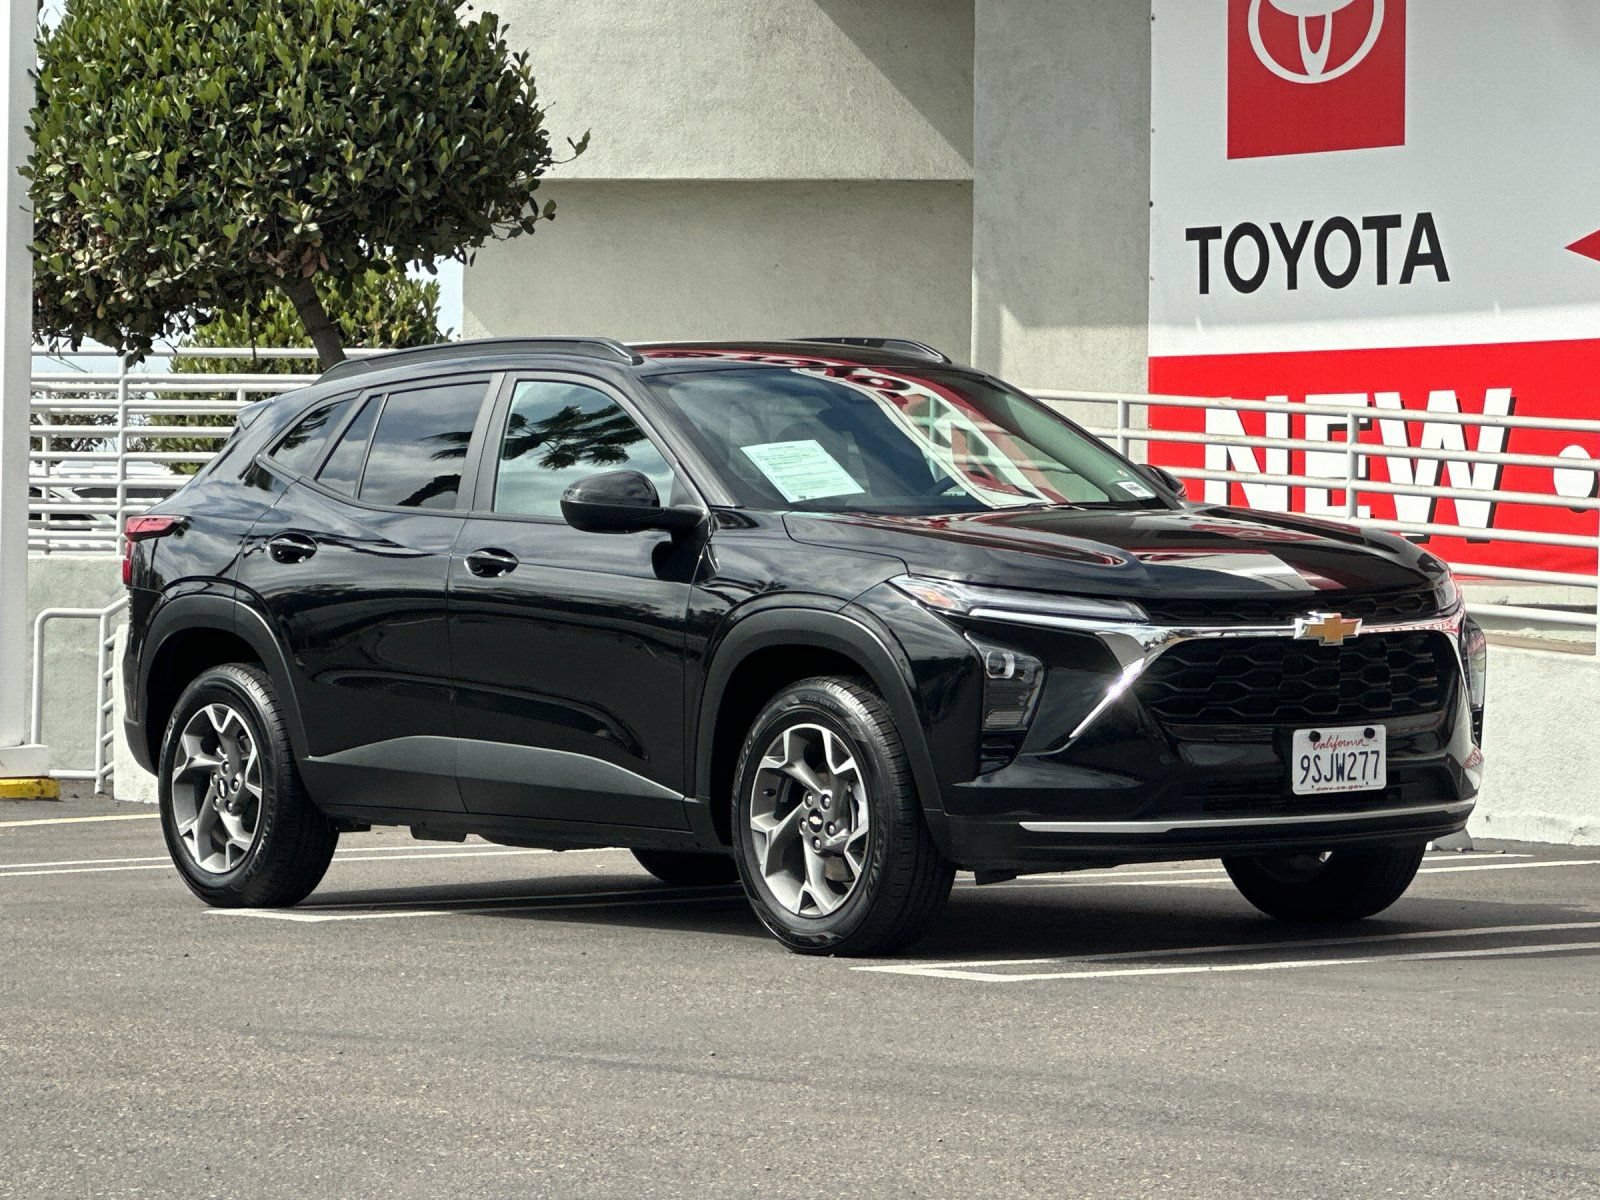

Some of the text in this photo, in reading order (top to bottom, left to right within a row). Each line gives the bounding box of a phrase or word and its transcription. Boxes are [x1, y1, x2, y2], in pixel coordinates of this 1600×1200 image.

[1186, 212, 1450, 295] TOYOTA
[1204, 387, 1516, 543] NEW
[1300, 750, 1380, 785] 9SJW277
[1311, 734, 1369, 753] California
